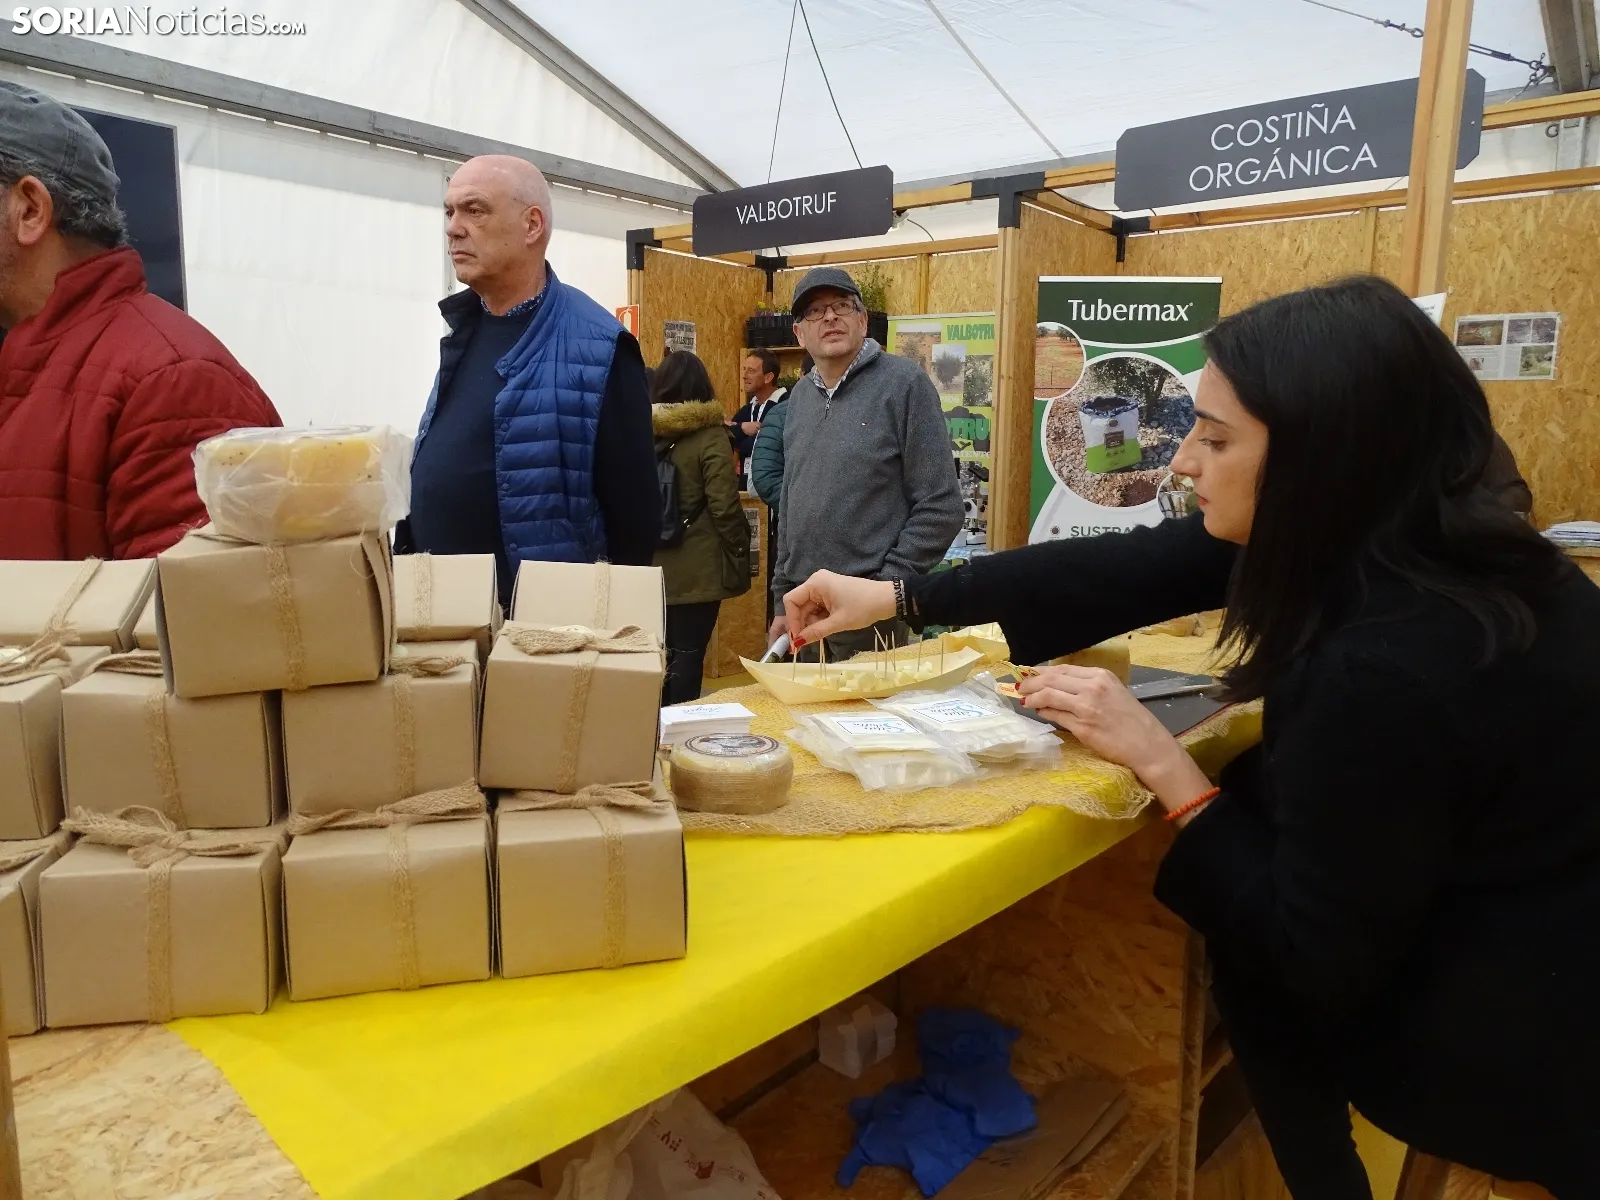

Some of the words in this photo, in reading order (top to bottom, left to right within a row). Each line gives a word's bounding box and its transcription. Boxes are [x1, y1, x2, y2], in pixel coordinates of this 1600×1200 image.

[1210, 102, 1357, 151] COSTIÑA
[1189, 143, 1378, 192] ORGÁNICA
[736, 191, 837, 225] VALBOTRUF
[1067, 298, 1190, 322] Tubermax
[946, 323, 995, 341] VALBOTRU
[1070, 525, 1138, 537] SUSTRA
